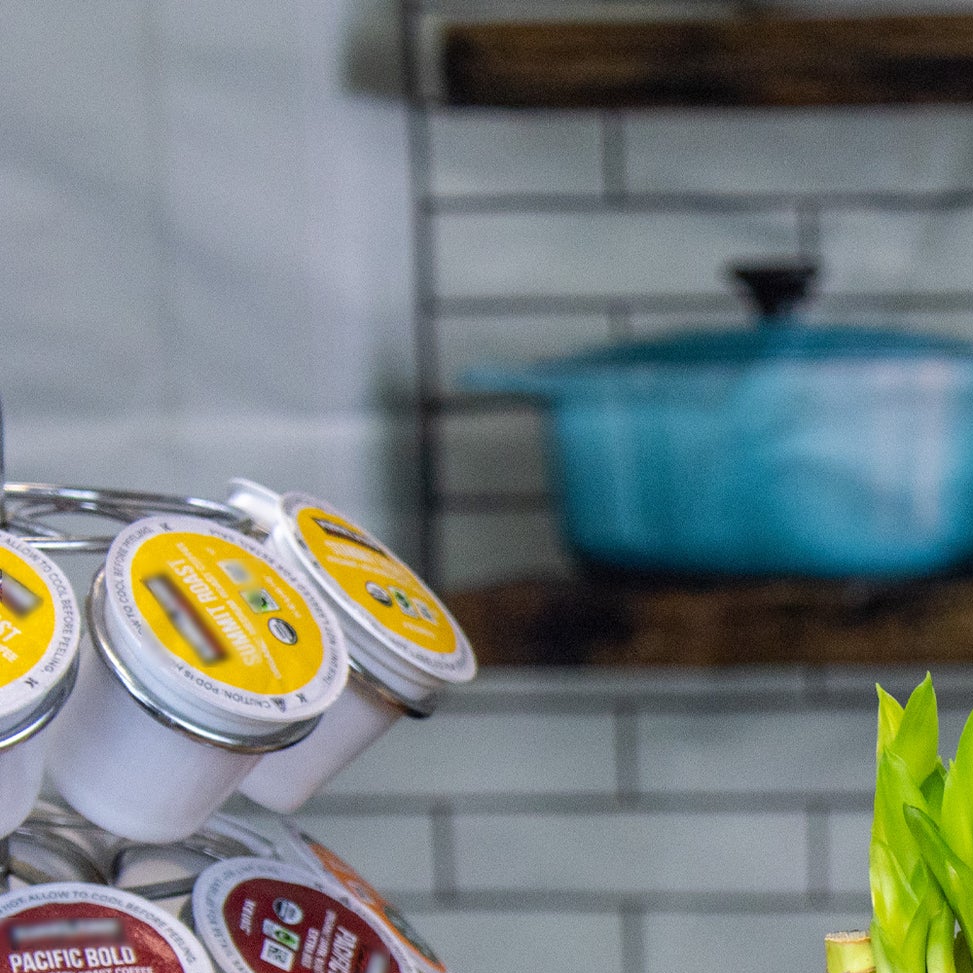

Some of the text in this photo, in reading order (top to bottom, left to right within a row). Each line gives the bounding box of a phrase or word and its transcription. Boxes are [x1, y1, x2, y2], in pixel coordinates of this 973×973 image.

[40, 559, 52, 572] TO
[48, 572, 67, 598] COOL
[62, 599, 73, 634] BEFORE
[167, 558, 218, 604] ROAST
[206, 604, 262, 666] SUMMIT
[195, 678, 219, 694] POD
[28, 891, 69, 901] ALLOW
[73, 891, 88, 899] TO
[91, 893, 122, 906] COOL
[125, 902, 167, 928] BEFORE
[8, 945, 137, 973] PACIFIC BOLD
